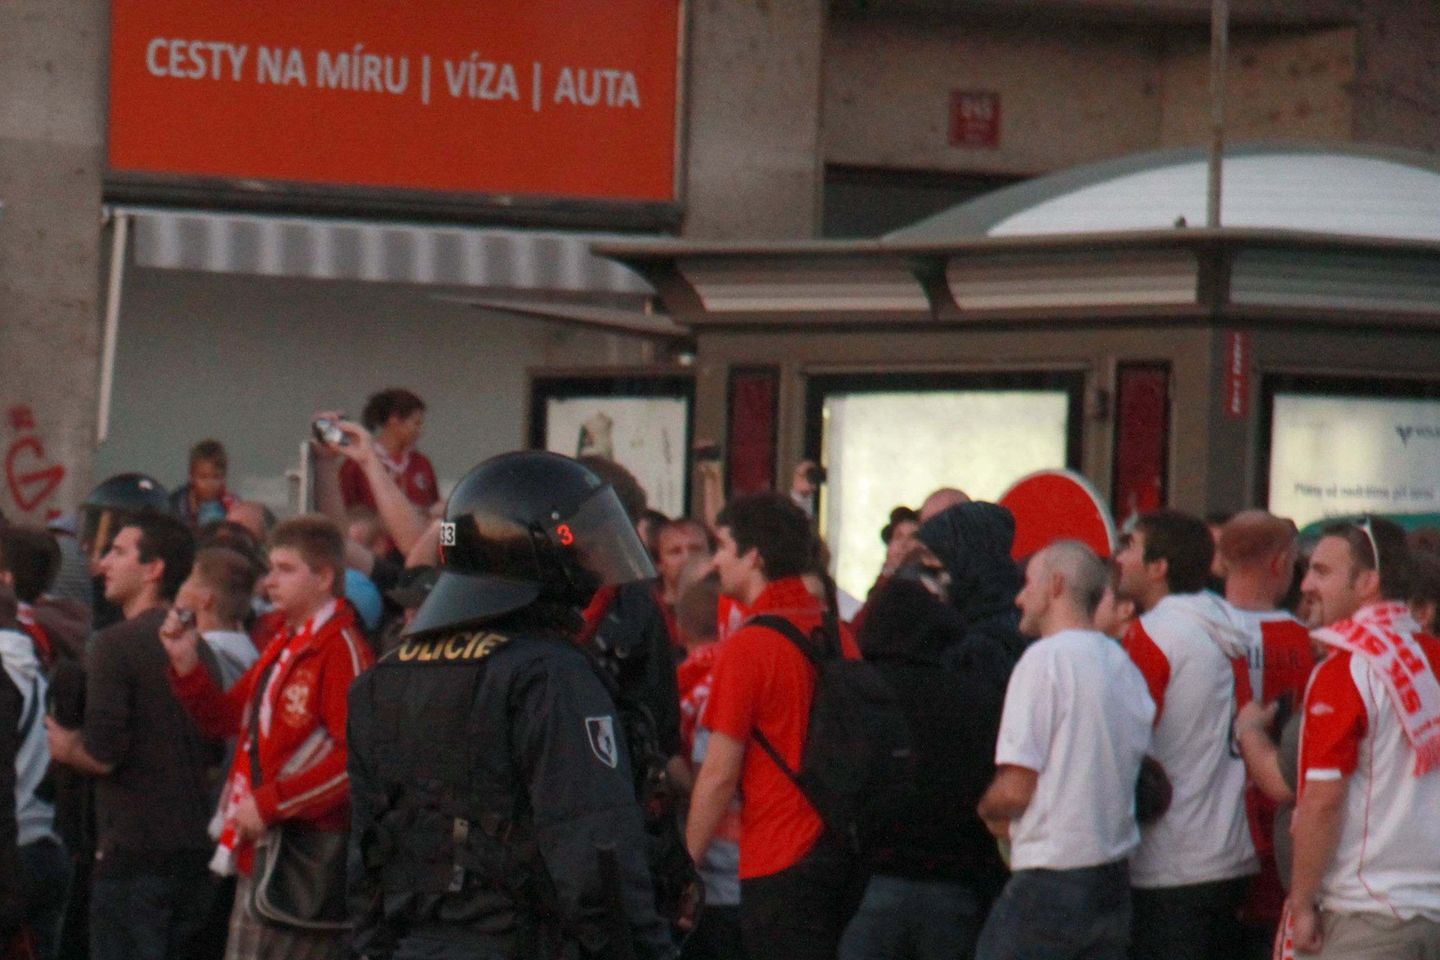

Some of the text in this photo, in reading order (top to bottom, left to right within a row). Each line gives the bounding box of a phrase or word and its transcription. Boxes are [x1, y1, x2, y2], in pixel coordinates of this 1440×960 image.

[146, 38, 641, 108] CESTY NA MÍRU VÍZA AUTA
[556, 524, 574, 545] 3
